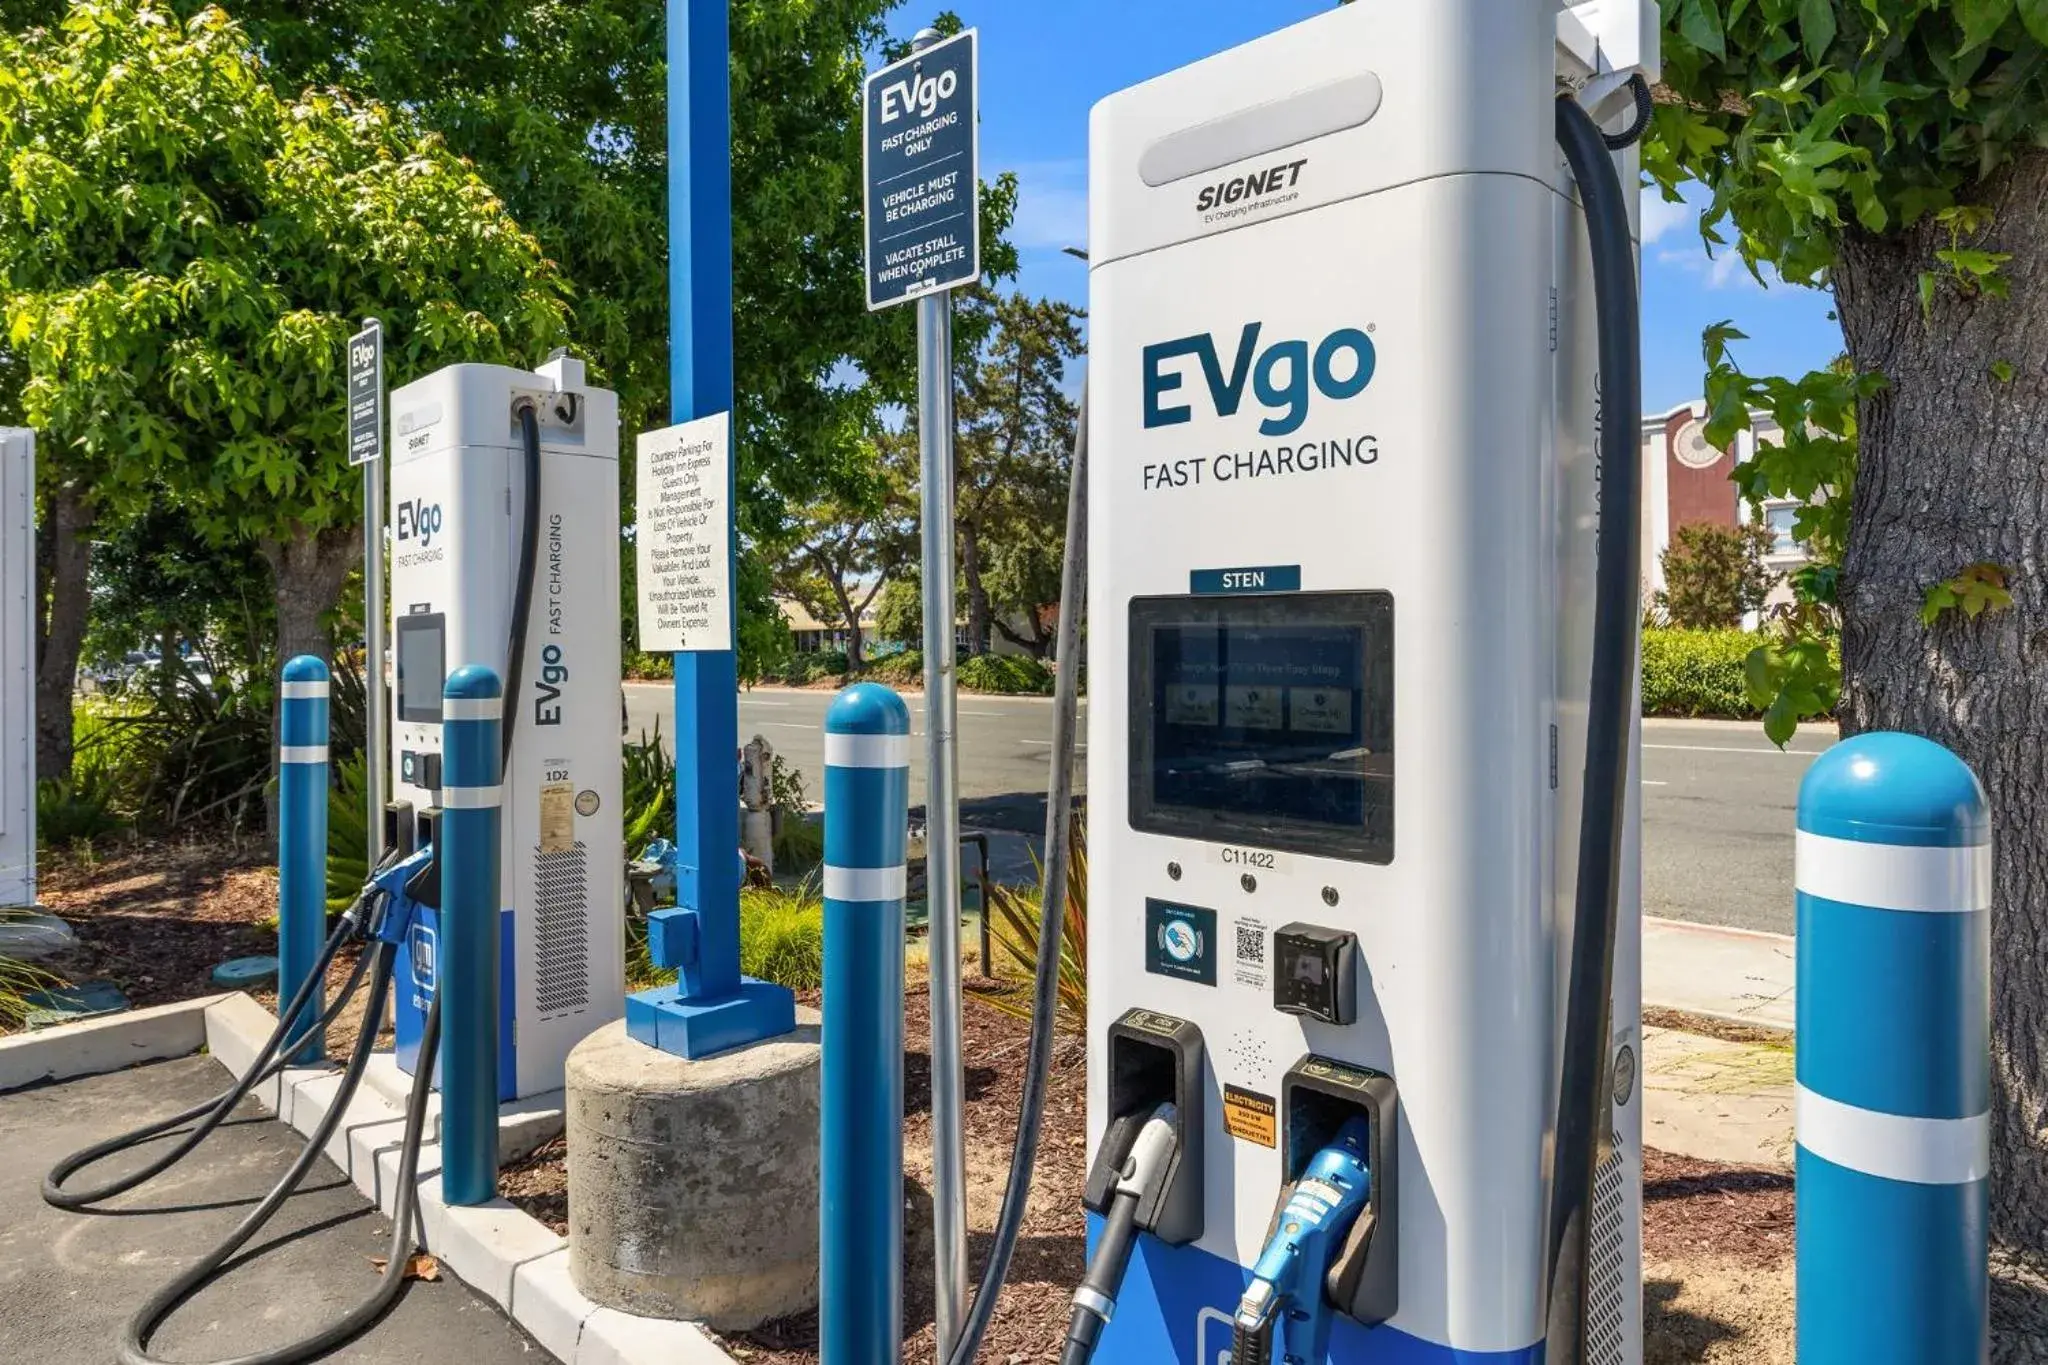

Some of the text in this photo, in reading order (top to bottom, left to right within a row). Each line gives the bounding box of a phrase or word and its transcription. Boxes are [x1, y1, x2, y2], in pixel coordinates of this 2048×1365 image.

[881, 69, 957, 124] EVgo
[881, 112, 957, 152] FAST CHARGING
[905, 136, 933, 157] ONLY
[882, 172, 958, 208] VEHICLE MUST
[1197, 159, 1308, 212] SIGNET
[886, 189, 954, 222] BE CHARGING
[1215, 205, 1247, 219] Charging
[885, 234, 956, 266] VACATE STALL
[878, 247, 965, 283] WHEN COMPLETE
[352, 345, 374, 368] EVgo
[1143, 321, 1376, 437] EVgo
[409, 434, 430, 450] SIGNET
[651, 441, 713, 463] Courtesy Parking For
[652, 465, 675, 477] Holiday
[687, 457, 711, 471] Express
[1144, 434, 1379, 491] FAST CHARGING
[662, 477, 683, 489] Guests
[660, 487, 701, 502] Management
[666, 501, 702, 517] Responsible
[703, 498, 714, 510] For
[398, 498, 441, 546] EVgo
[653, 521, 666, 531] Loss
[677, 516, 697, 528] Vehicle
[699, 513, 708, 525] Or
[398, 548, 442, 568] FAST CHARGING
[651, 543, 711, 560] Please Remove Your
[550, 514, 561, 634] FAST CHARGING
[652, 556, 711, 573] Valuables And Lock
[663, 576, 676, 586] Your
[1222, 571, 1265, 589] STEN
[649, 588, 716, 601] Unauthorized Vehicles
[670, 602, 678, 614] Be
[680, 602, 699, 613] Towed
[658, 618, 680, 629] Owners
[535, 644, 568, 725] EVgo
[546, 770, 568, 781] 1D2
[1222, 848, 1274, 869] C11422
[1225, 1092, 1274, 1113] ELECTRICITY
